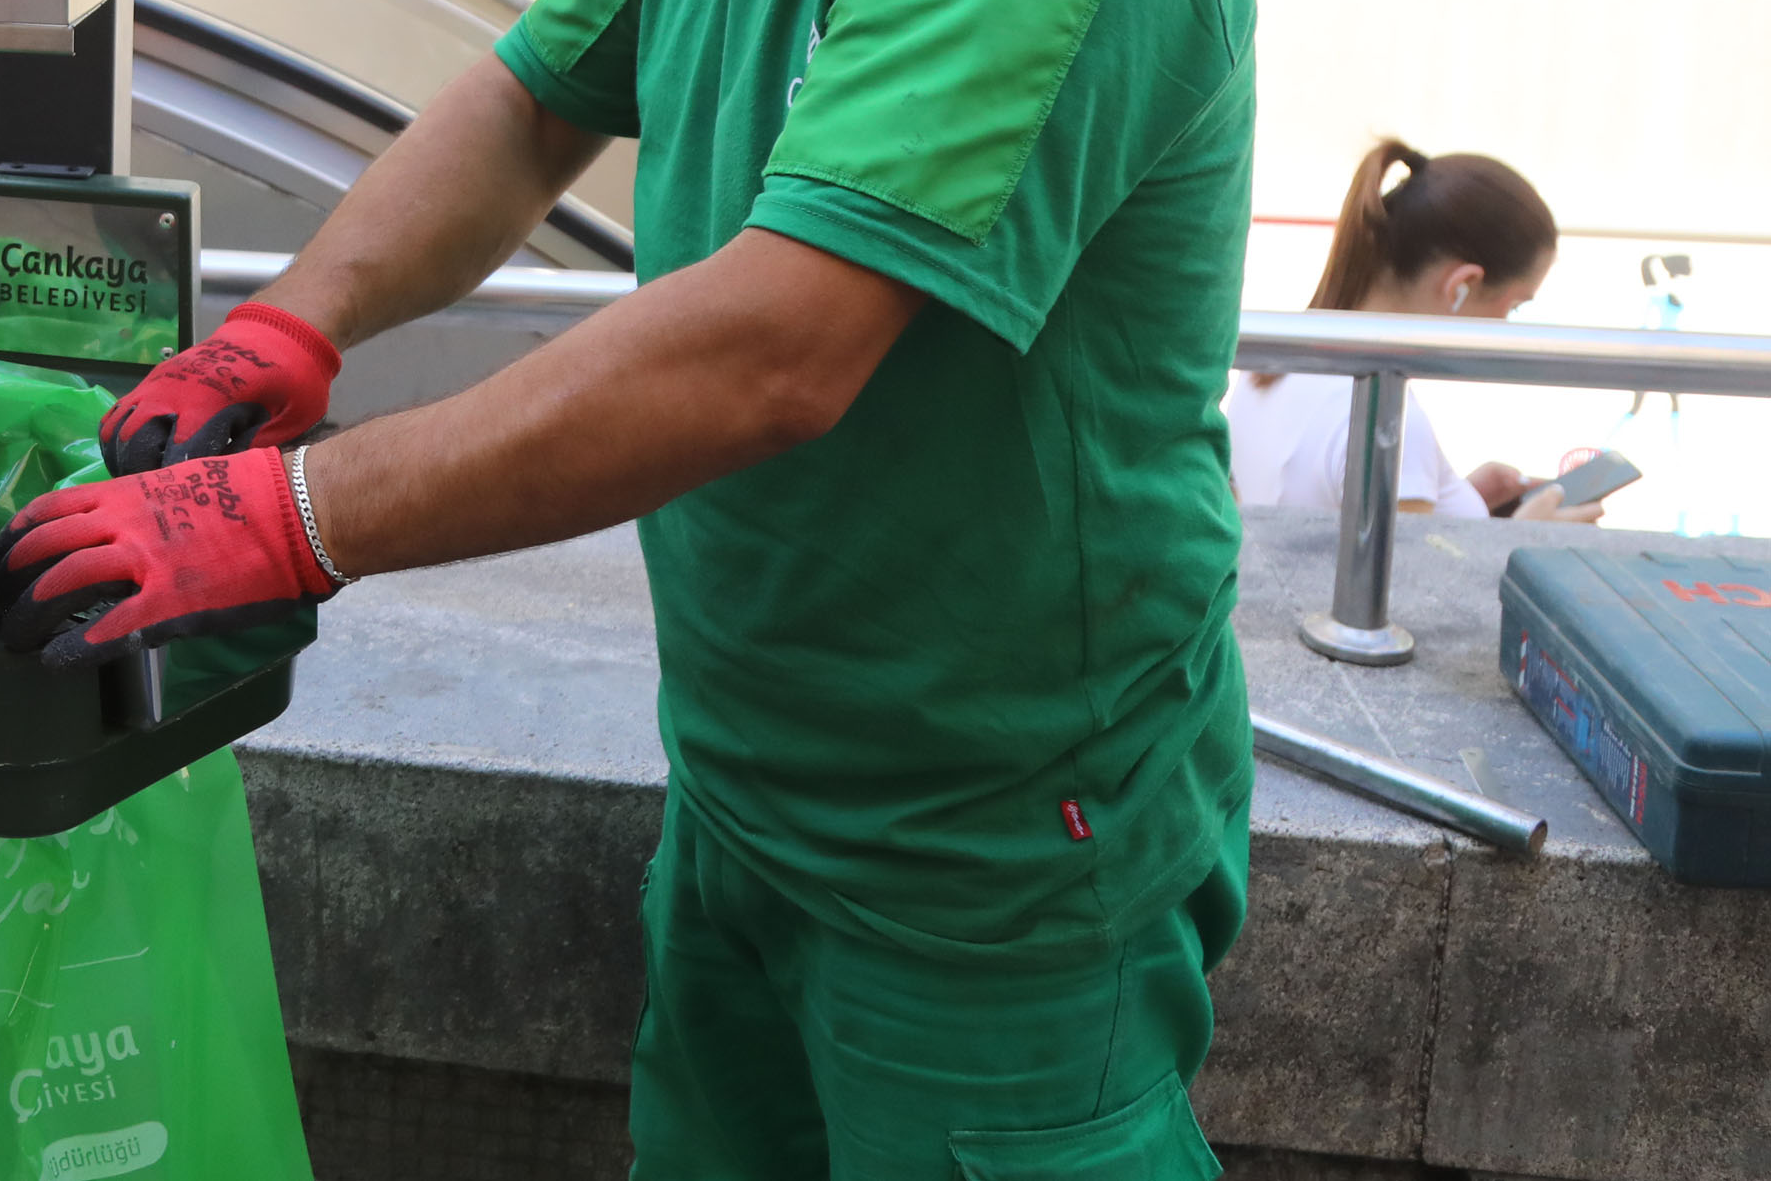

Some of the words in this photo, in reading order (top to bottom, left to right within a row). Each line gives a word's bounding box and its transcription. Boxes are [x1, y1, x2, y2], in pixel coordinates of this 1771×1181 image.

[0, 242, 149, 288] Çankaya
[0, 282, 147, 315] BELEDİYESİ
[1660, 579, 1771, 609] CH
